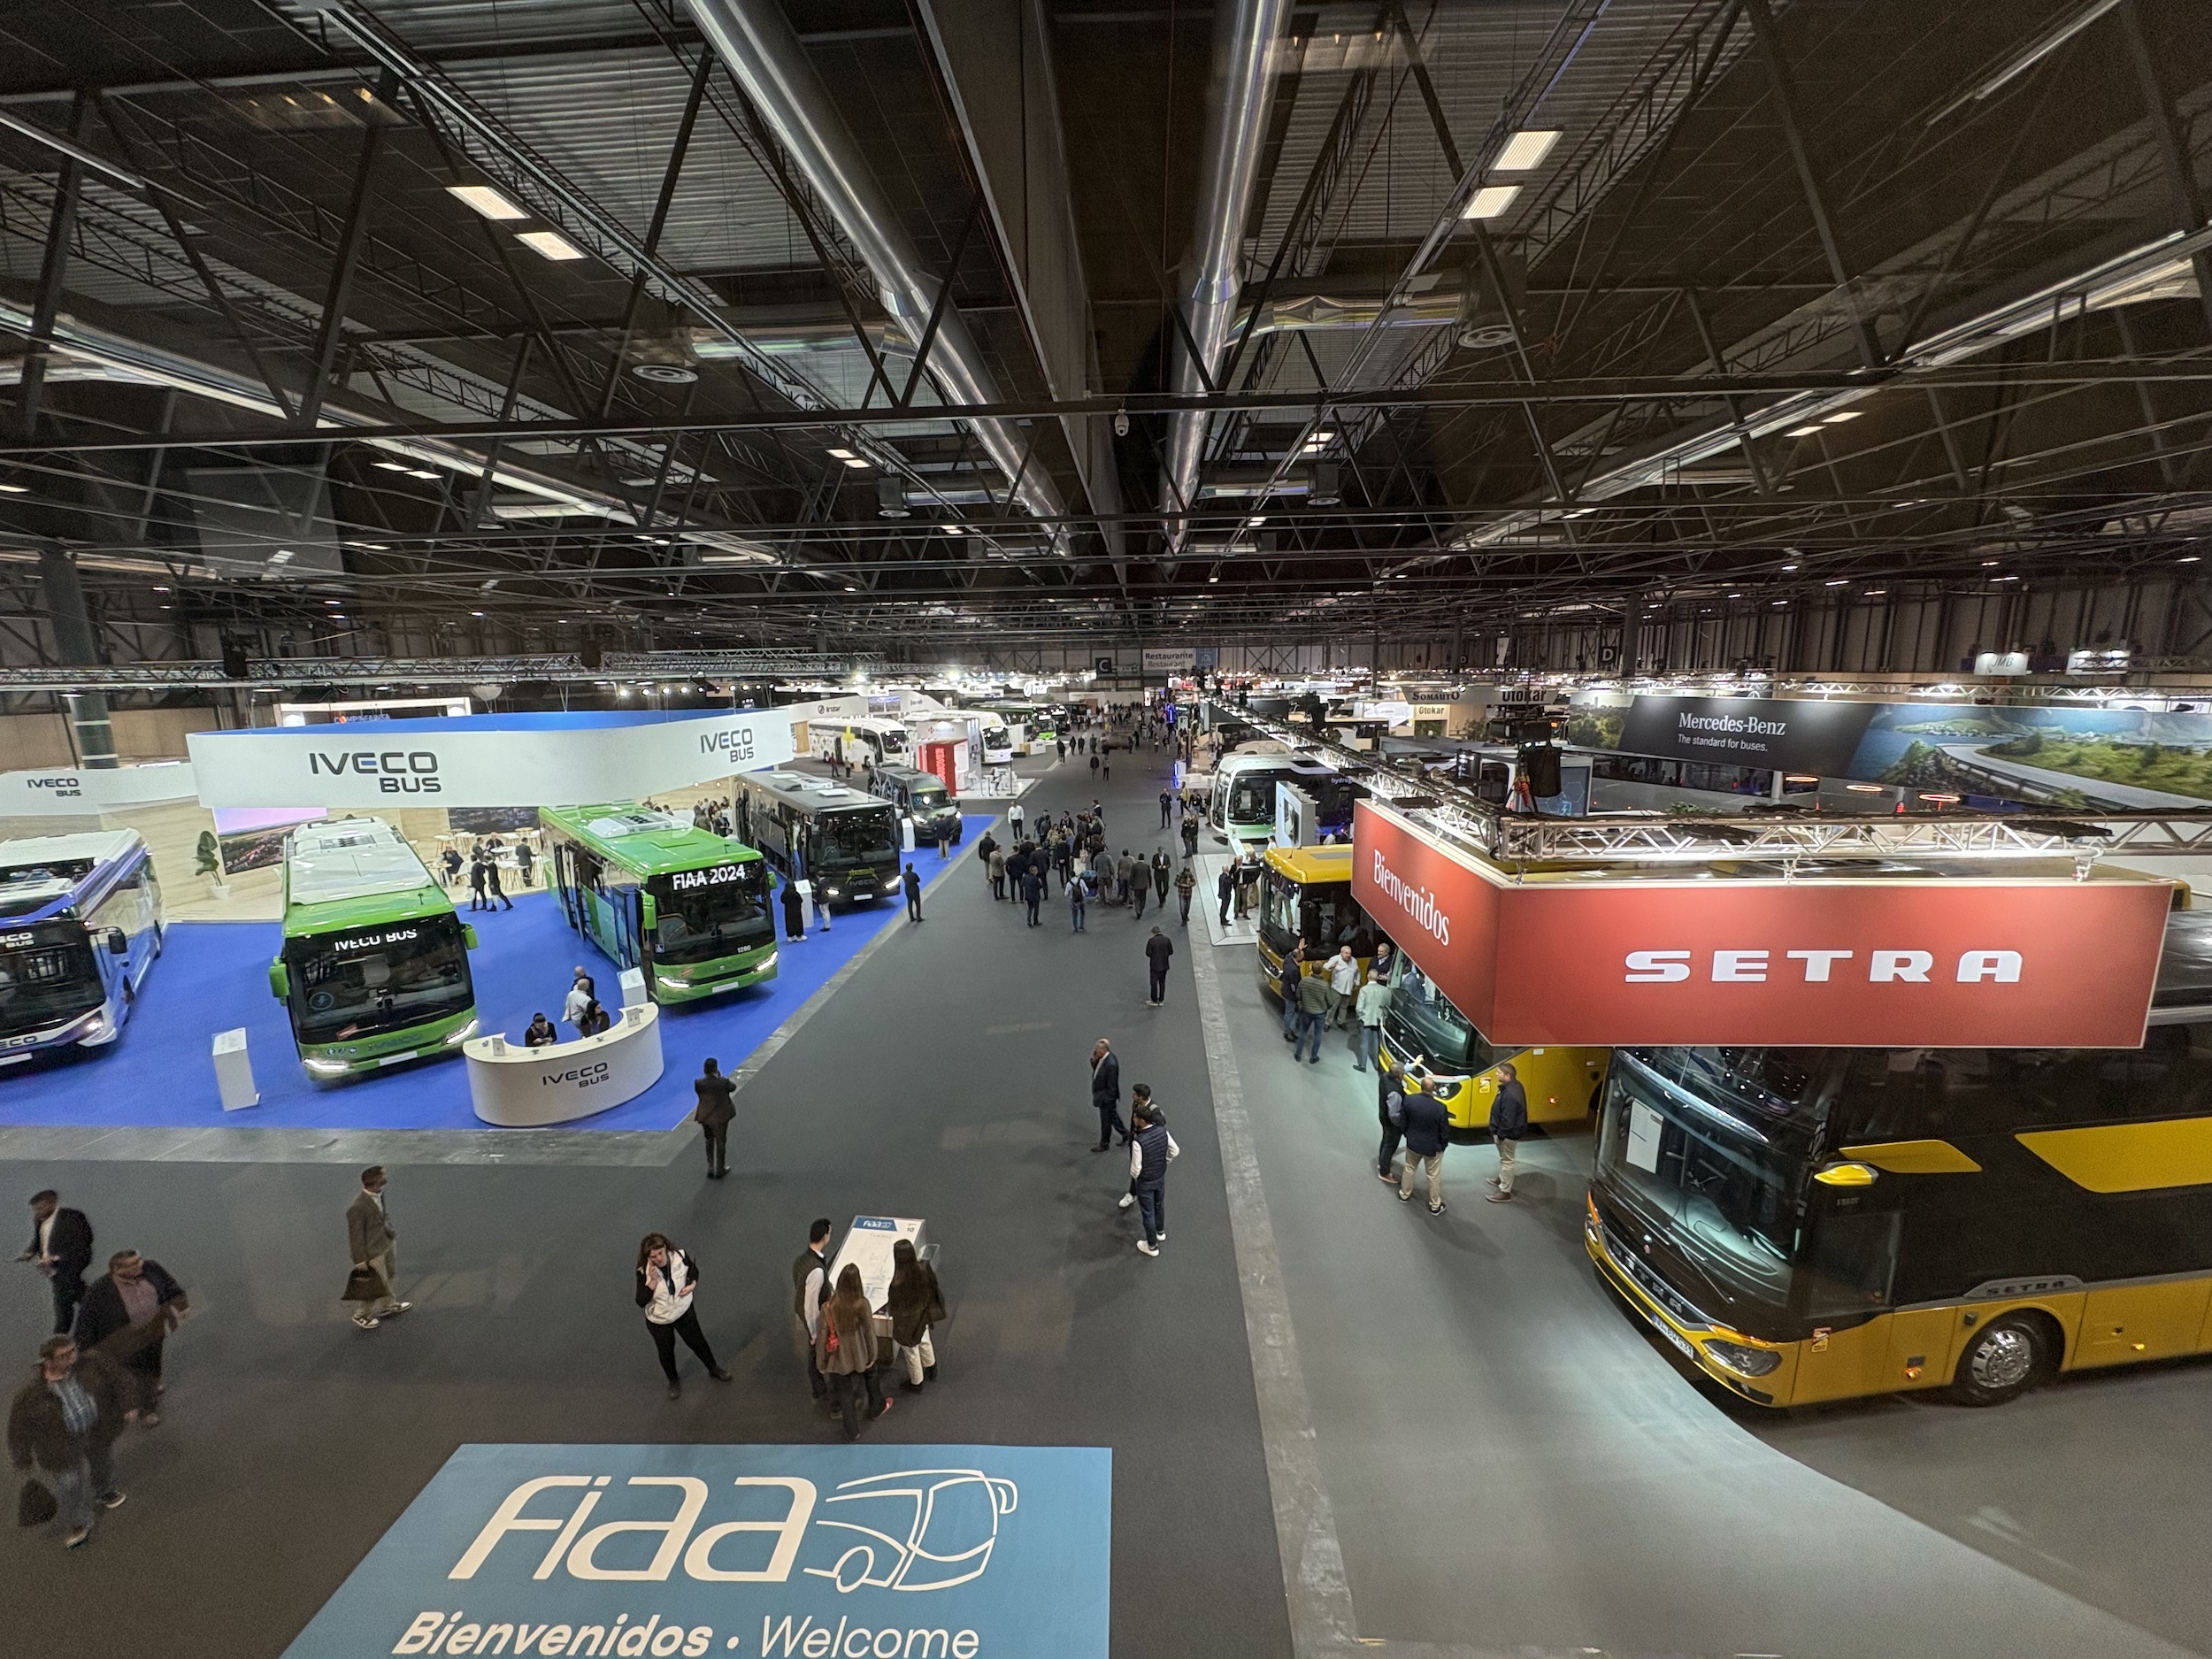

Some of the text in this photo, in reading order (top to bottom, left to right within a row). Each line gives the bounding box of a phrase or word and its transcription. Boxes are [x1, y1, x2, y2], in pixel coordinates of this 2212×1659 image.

[1601, 649, 1614, 661] D
[1098, 659, 1109, 672] C
[1418, 706, 1444, 715] Otokar
[1678, 712, 1786, 736] Mercedes-Benz
[700, 728, 753, 754] IVECO
[1678, 733, 1769, 752] The standard for buses.
[309, 751, 439, 775] IVECO
[730, 747, 754, 763] BUS
[27, 778, 79, 788] IVECO
[379, 777, 442, 793] BUS
[672, 864, 746, 890] FIAA 2024
[1374, 849, 1450, 947] Bienvenidos
[5, 939, 35, 949] BUS
[736, 944, 752, 953] 1280
[1624, 949, 2023, 983] SETRA
[541, 1062, 608, 1086] IVECO
[579, 1072, 610, 1088] BUS
[1985, 1280, 2065, 1294] SETRA
[448, 1475, 818, 1582] fiaa
[391, 1610, 979, 1659] Bienvenidos Welcome
